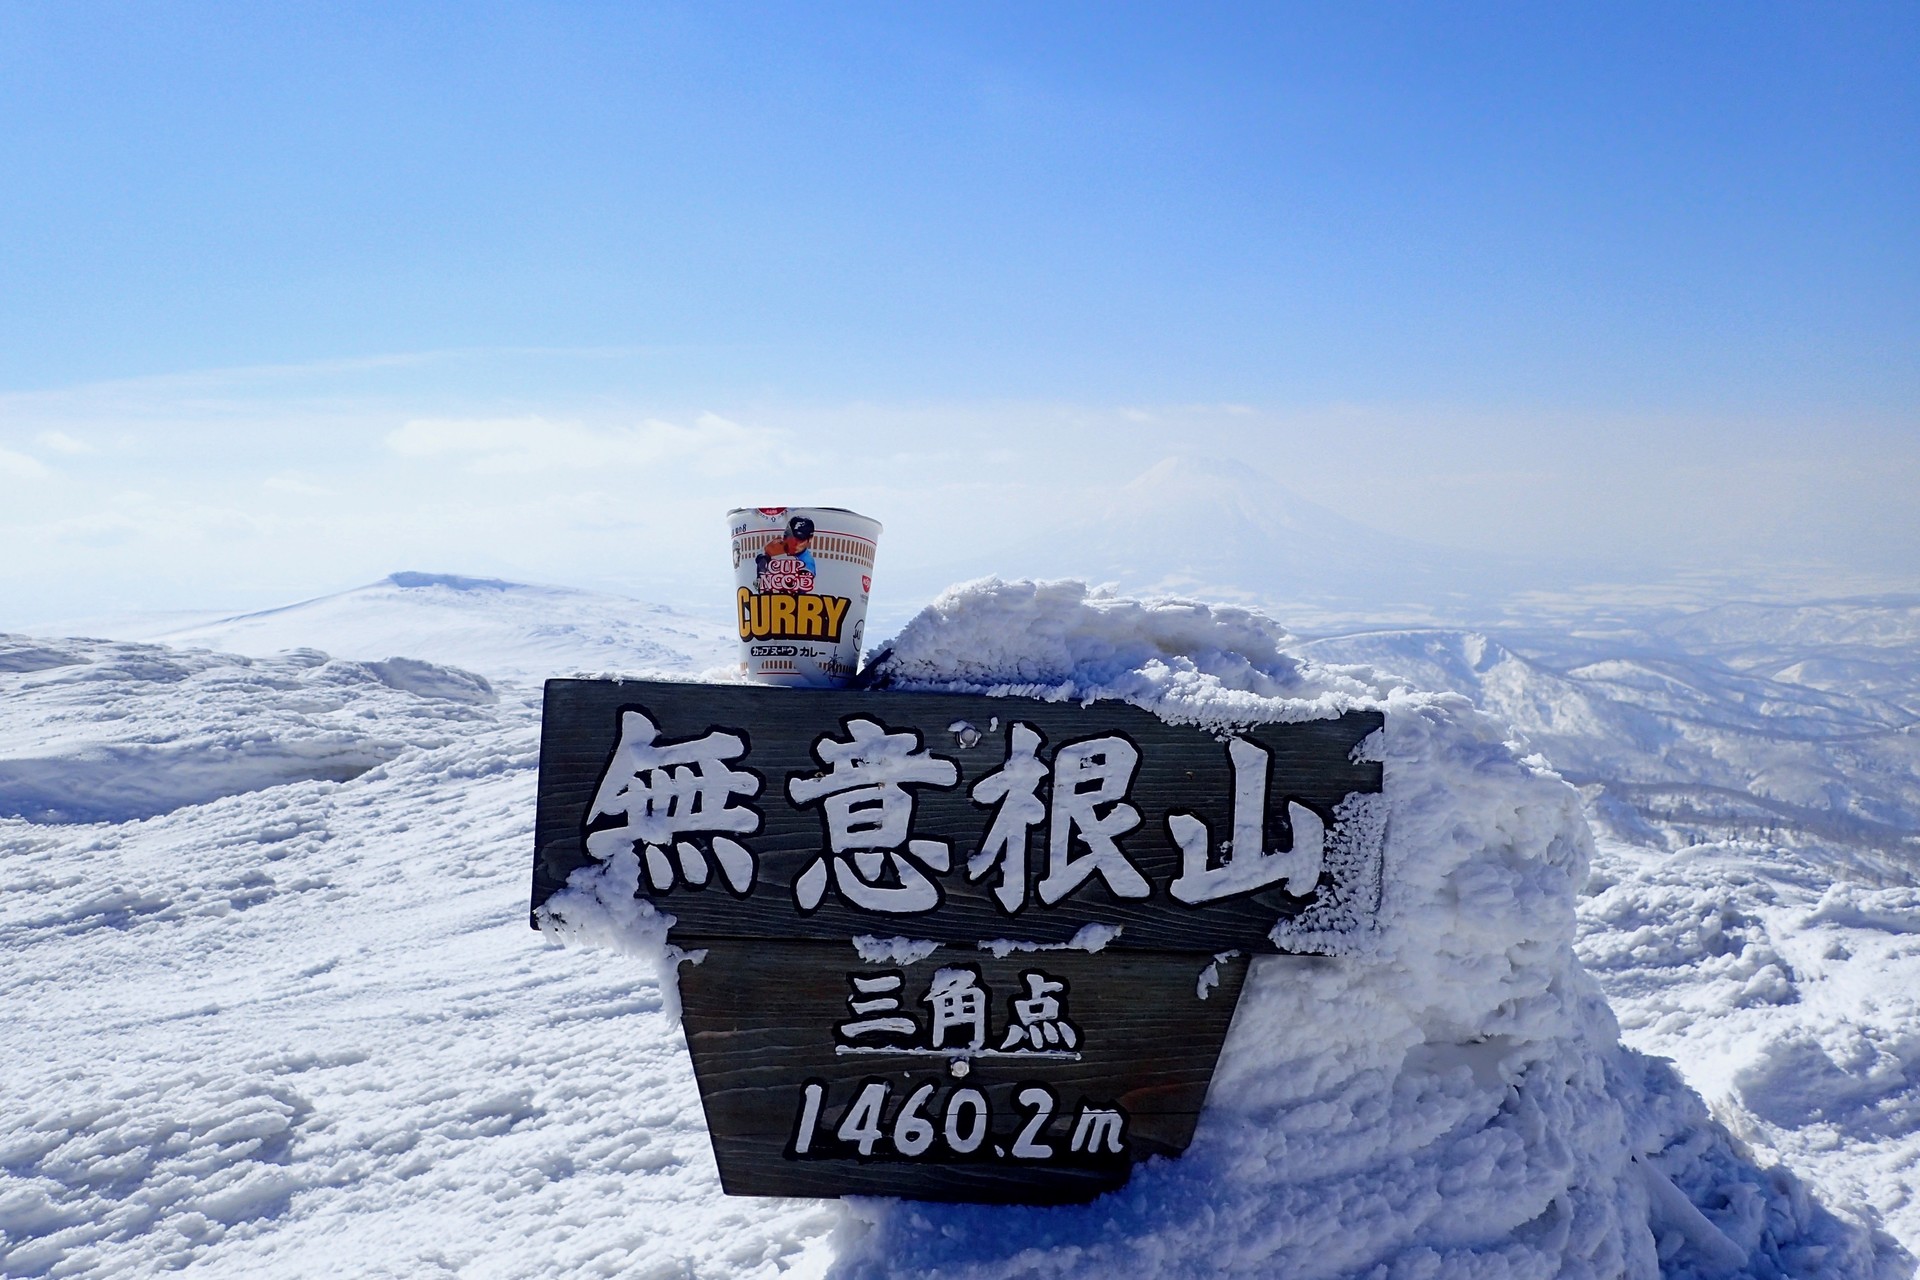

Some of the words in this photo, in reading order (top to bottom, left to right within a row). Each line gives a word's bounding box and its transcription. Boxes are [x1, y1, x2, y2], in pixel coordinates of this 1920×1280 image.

[768, 559, 804, 574] CUP
[737, 587, 851, 643] CURRY
[799, 646, 826, 657] カレー
[587, 709, 1324, 913] 無意根山
[840, 968, 1078, 1050] 三角点
